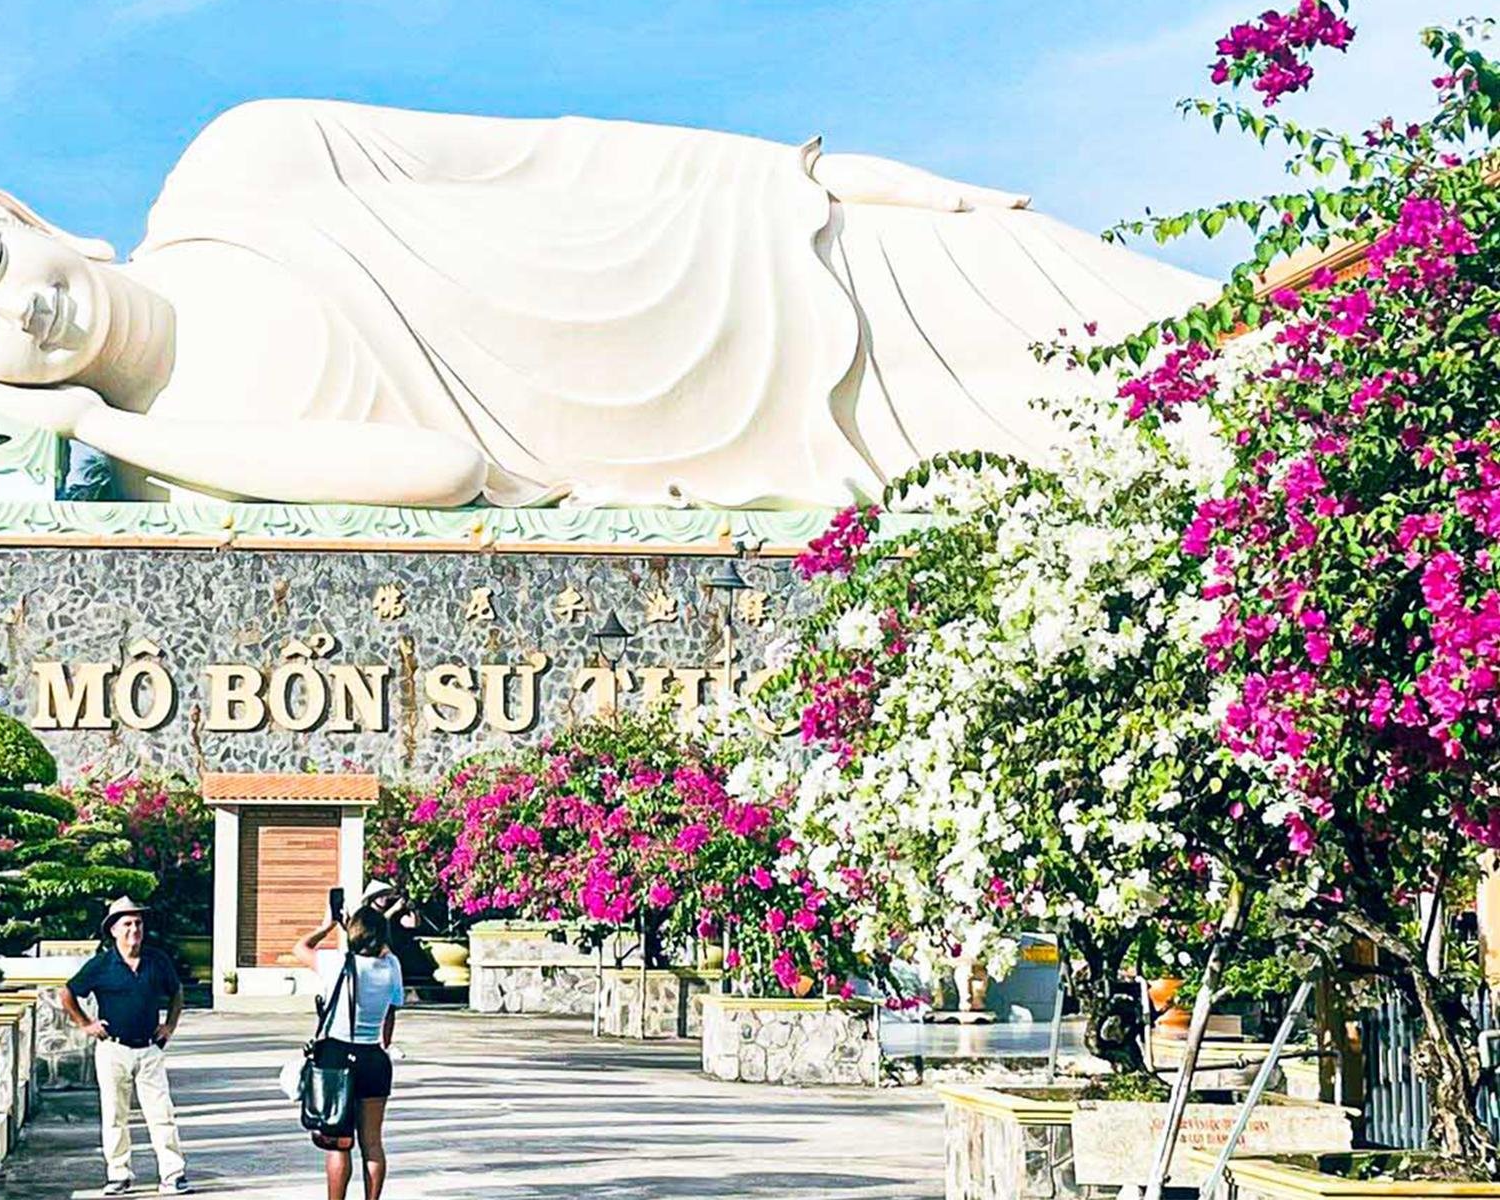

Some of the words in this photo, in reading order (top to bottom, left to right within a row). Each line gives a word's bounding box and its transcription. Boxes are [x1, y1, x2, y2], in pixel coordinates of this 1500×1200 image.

[33, 639, 174, 730] MÔ
[202, 633, 390, 731] BỔN
[425, 654, 550, 732] SƯ
